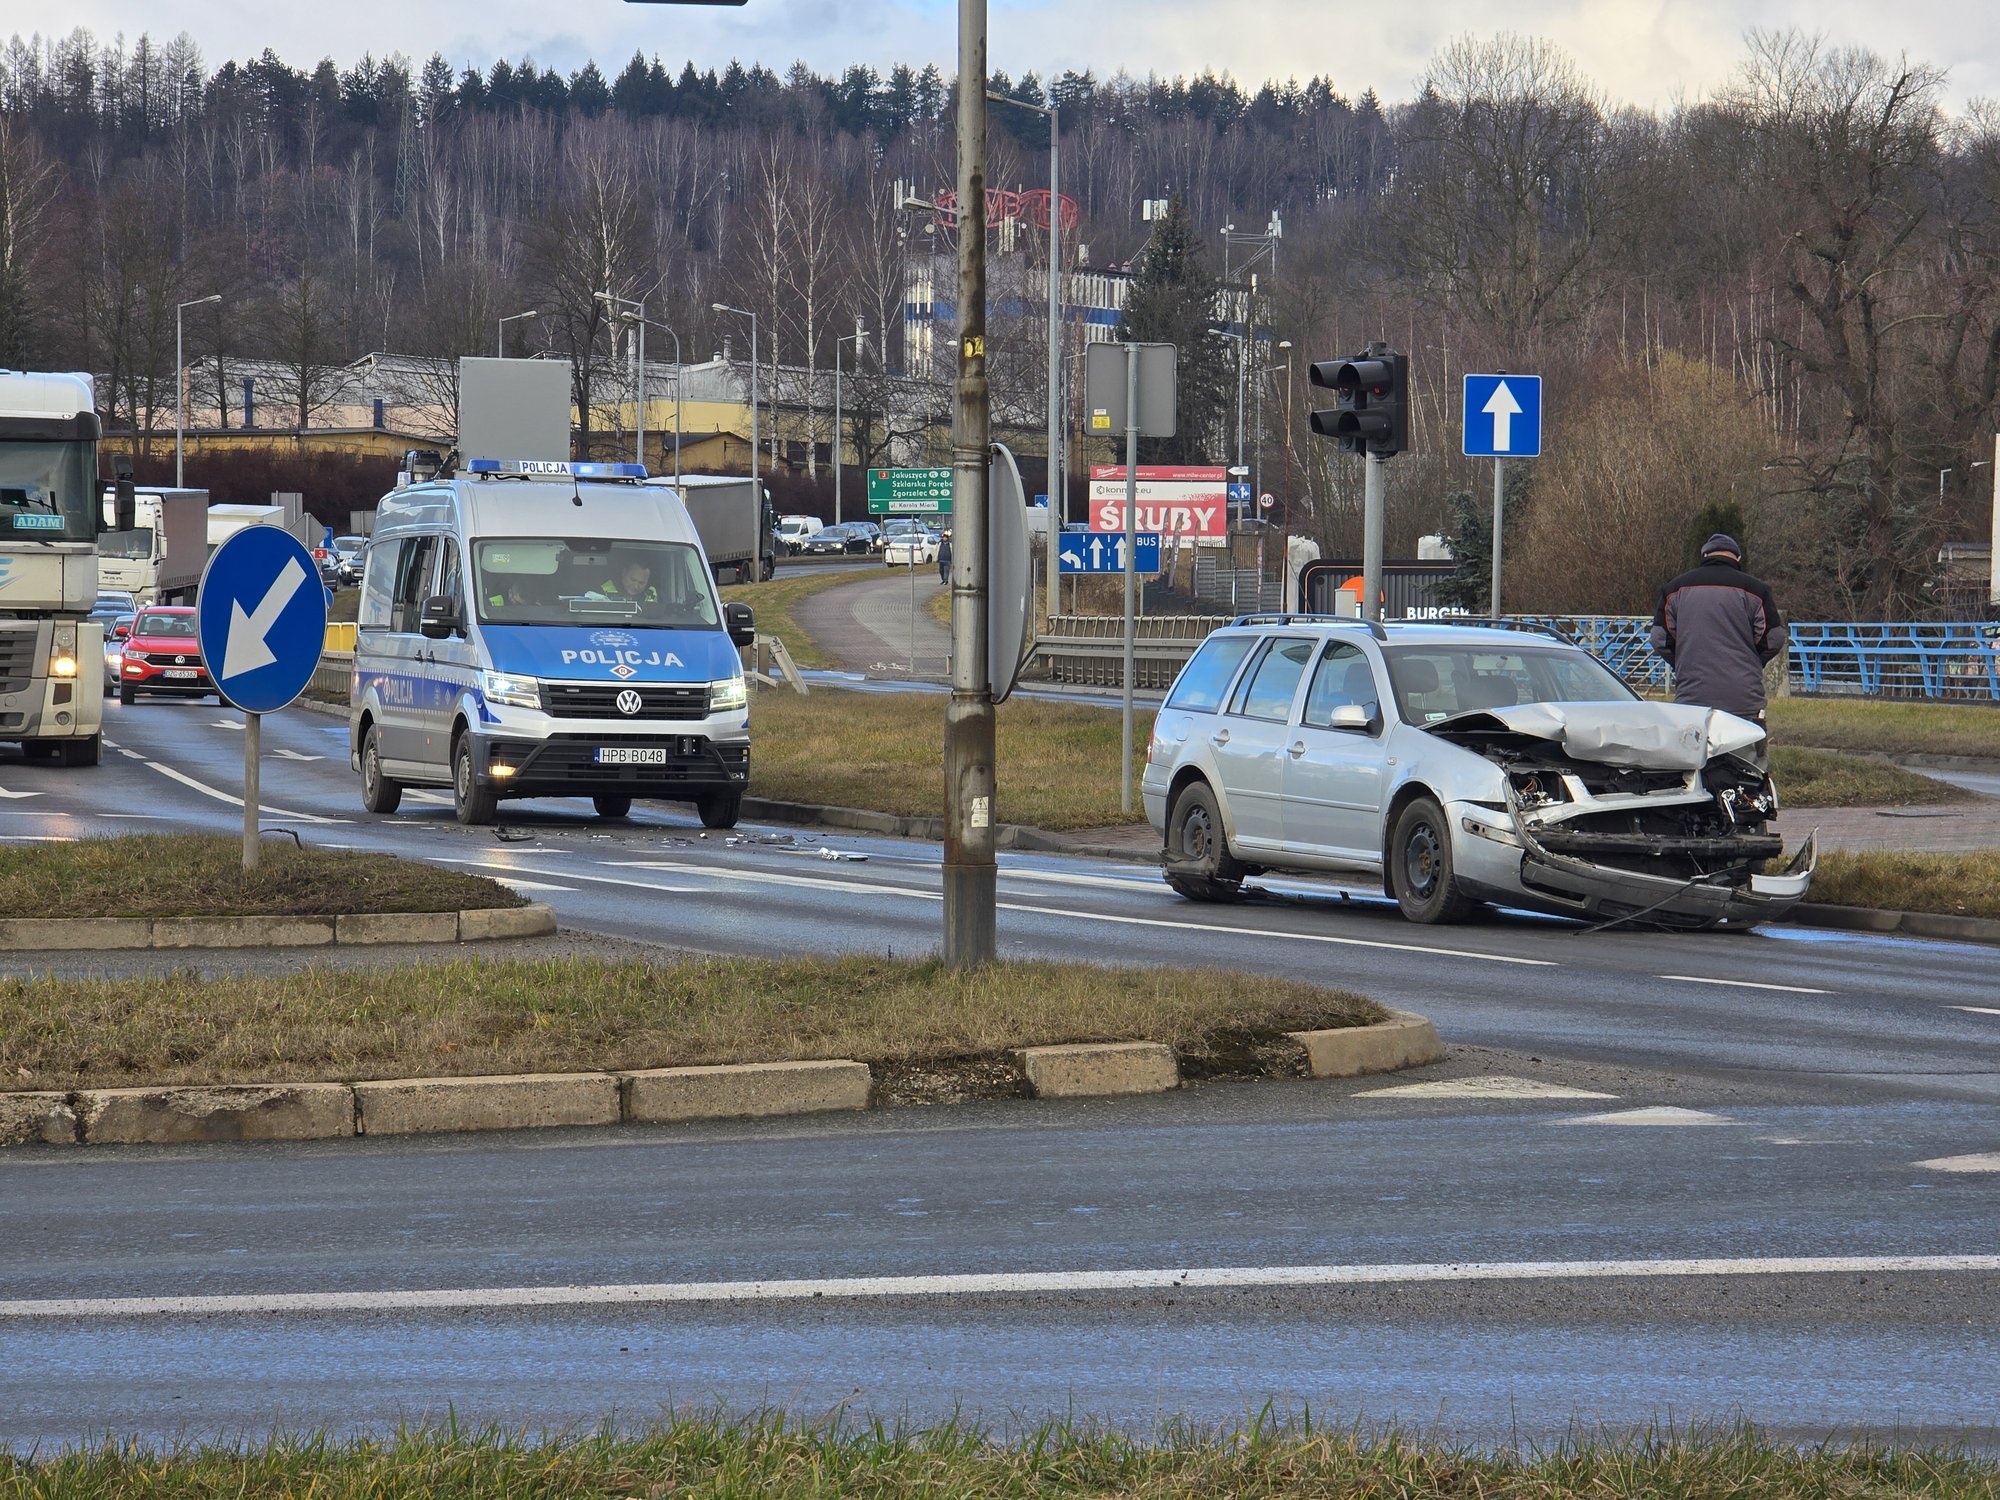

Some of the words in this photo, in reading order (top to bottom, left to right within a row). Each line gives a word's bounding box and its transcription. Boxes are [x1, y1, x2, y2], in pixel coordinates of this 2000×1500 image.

[522, 462, 568, 473] POLICJA
[892, 472, 927, 480] Jakuszyce
[892, 480, 926, 488] Szklarska
[892, 490, 928, 498] Zgorzelec
[1261, 496, 1272, 504] 40
[1099, 501, 1217, 531] ŚRUBY
[16, 517, 60, 528] ADAM
[1136, 537, 1156, 547] BUS
[318, 550, 324, 558] 3
[560, 650, 685, 668] POLICJA
[602, 749, 627, 762] HPB
[631, 750, 663, 762] B048
